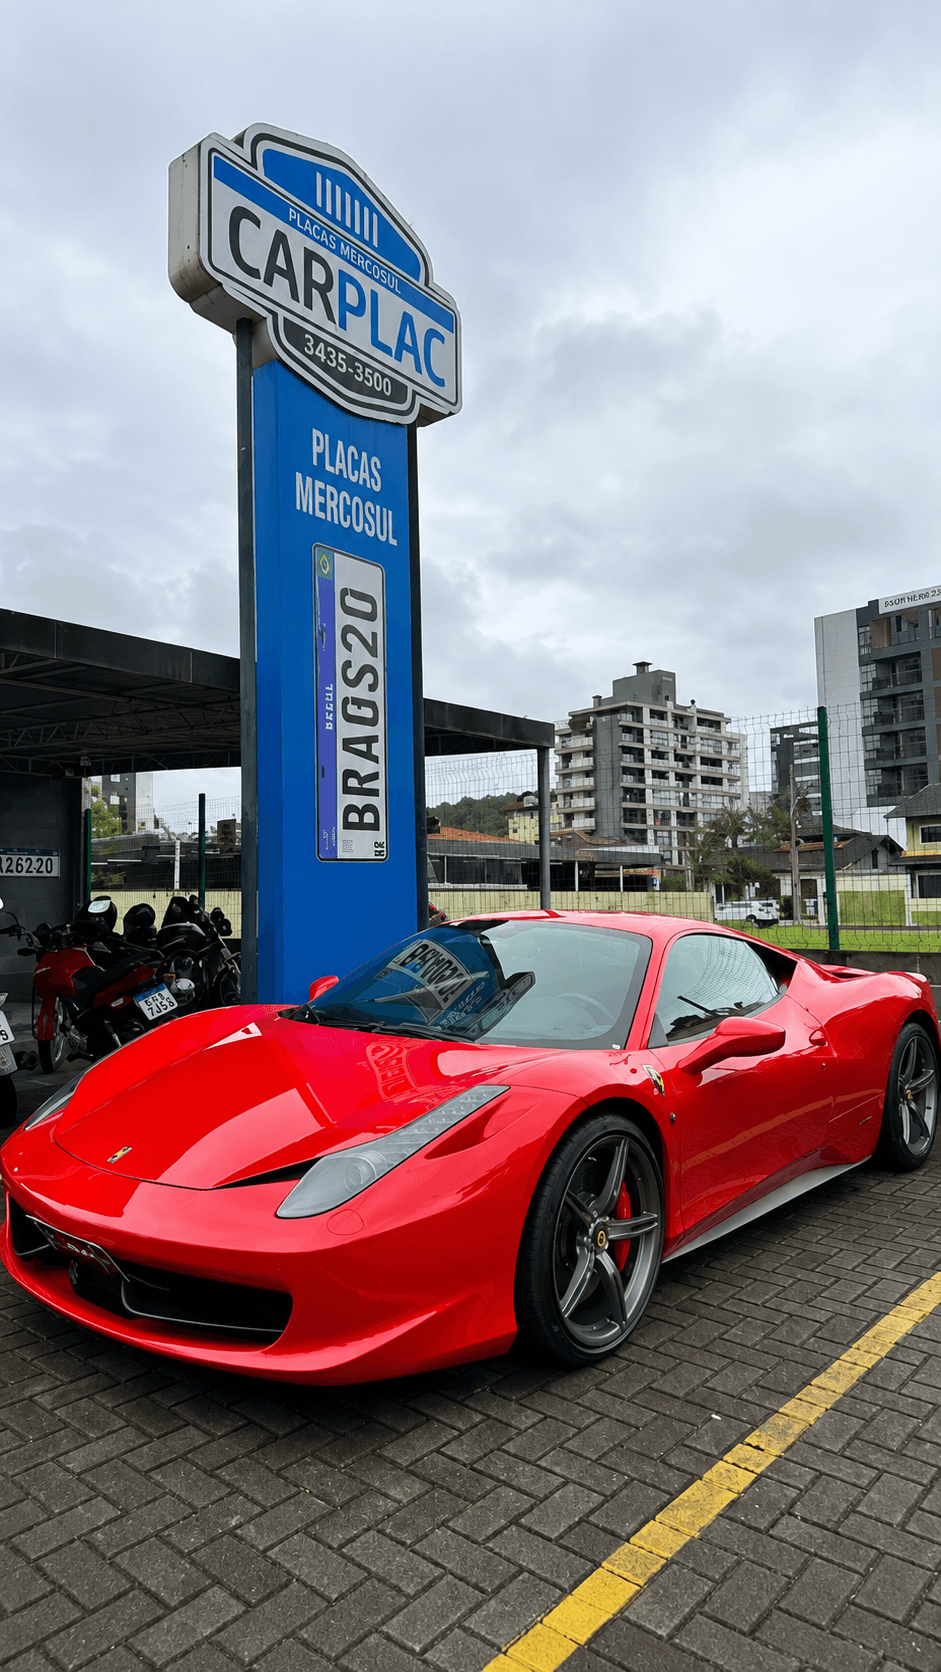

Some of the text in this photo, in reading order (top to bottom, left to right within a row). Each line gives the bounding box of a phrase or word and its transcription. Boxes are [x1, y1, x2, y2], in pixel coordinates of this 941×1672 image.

[289, 207, 402, 295] PLACAS MERCOSUL
[229, 205, 446, 388] CARPLAC
[303, 333, 392, 396] 3435-3500
[311, 427, 382, 493] PLACAS
[295, 470, 398, 547] MERCOSUL
